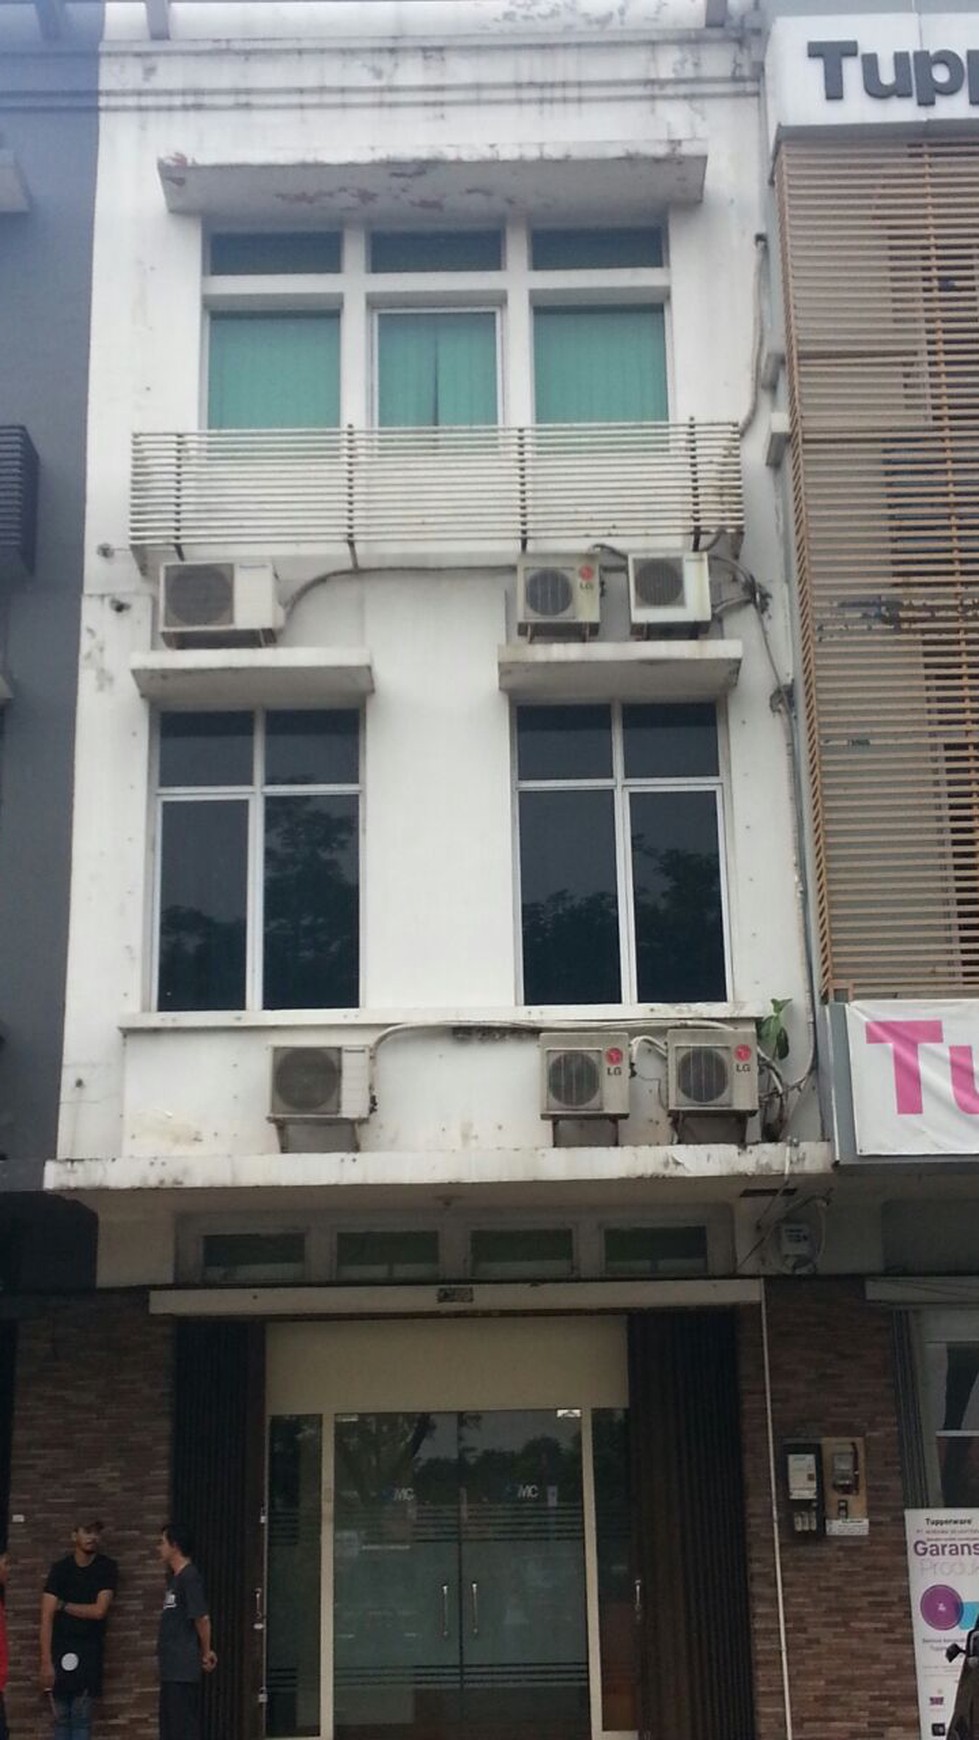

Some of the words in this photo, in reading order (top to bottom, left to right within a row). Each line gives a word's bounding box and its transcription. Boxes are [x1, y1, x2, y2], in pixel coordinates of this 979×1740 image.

[807, 40, 979, 106] Tup
[606, 1067, 622, 1077] LG
[736, 1063, 751, 1073] LG
[925, 1518, 972, 1526] Tupperware
